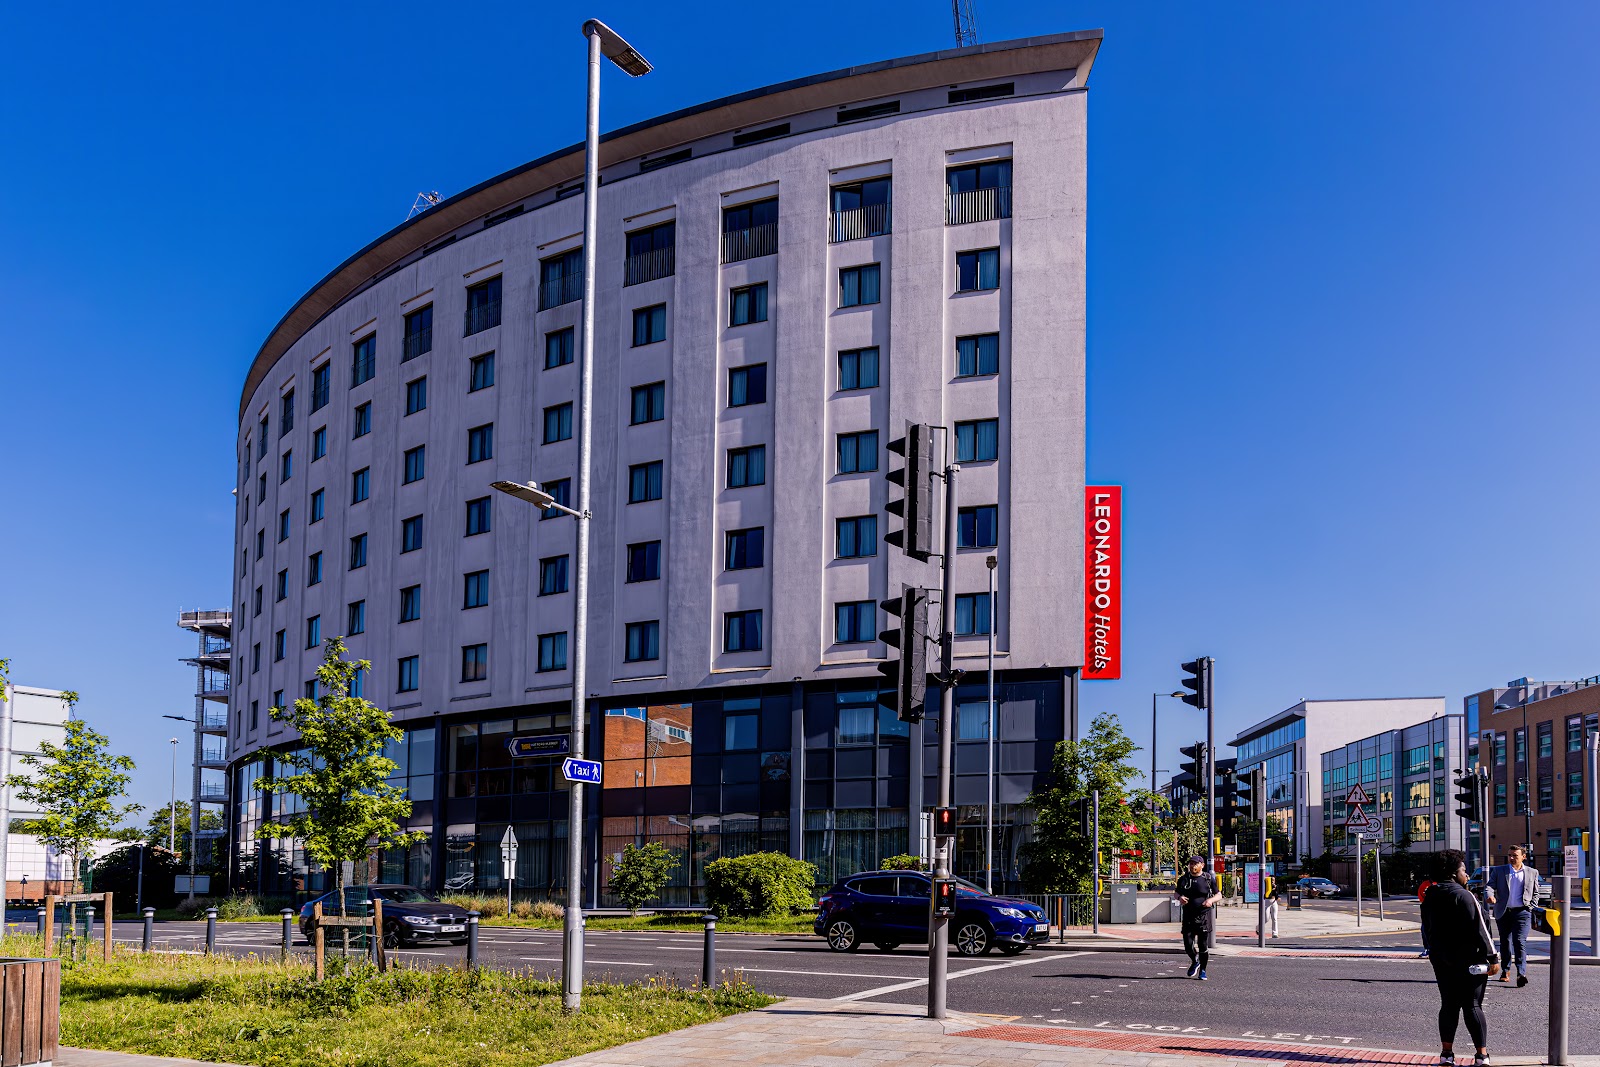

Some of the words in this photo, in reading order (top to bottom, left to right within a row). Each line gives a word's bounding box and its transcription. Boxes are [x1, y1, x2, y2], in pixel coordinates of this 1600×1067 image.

[1095, 493, 1111, 609] LEONARDO
[1095, 613, 1111, 669] Hotels
[573, 763, 590, 777] Taxi
[1367, 821, 1379, 829] 20
[1094, 1021, 1210, 1034] LOOK
[1241, 1030, 1363, 1044] LEFT
